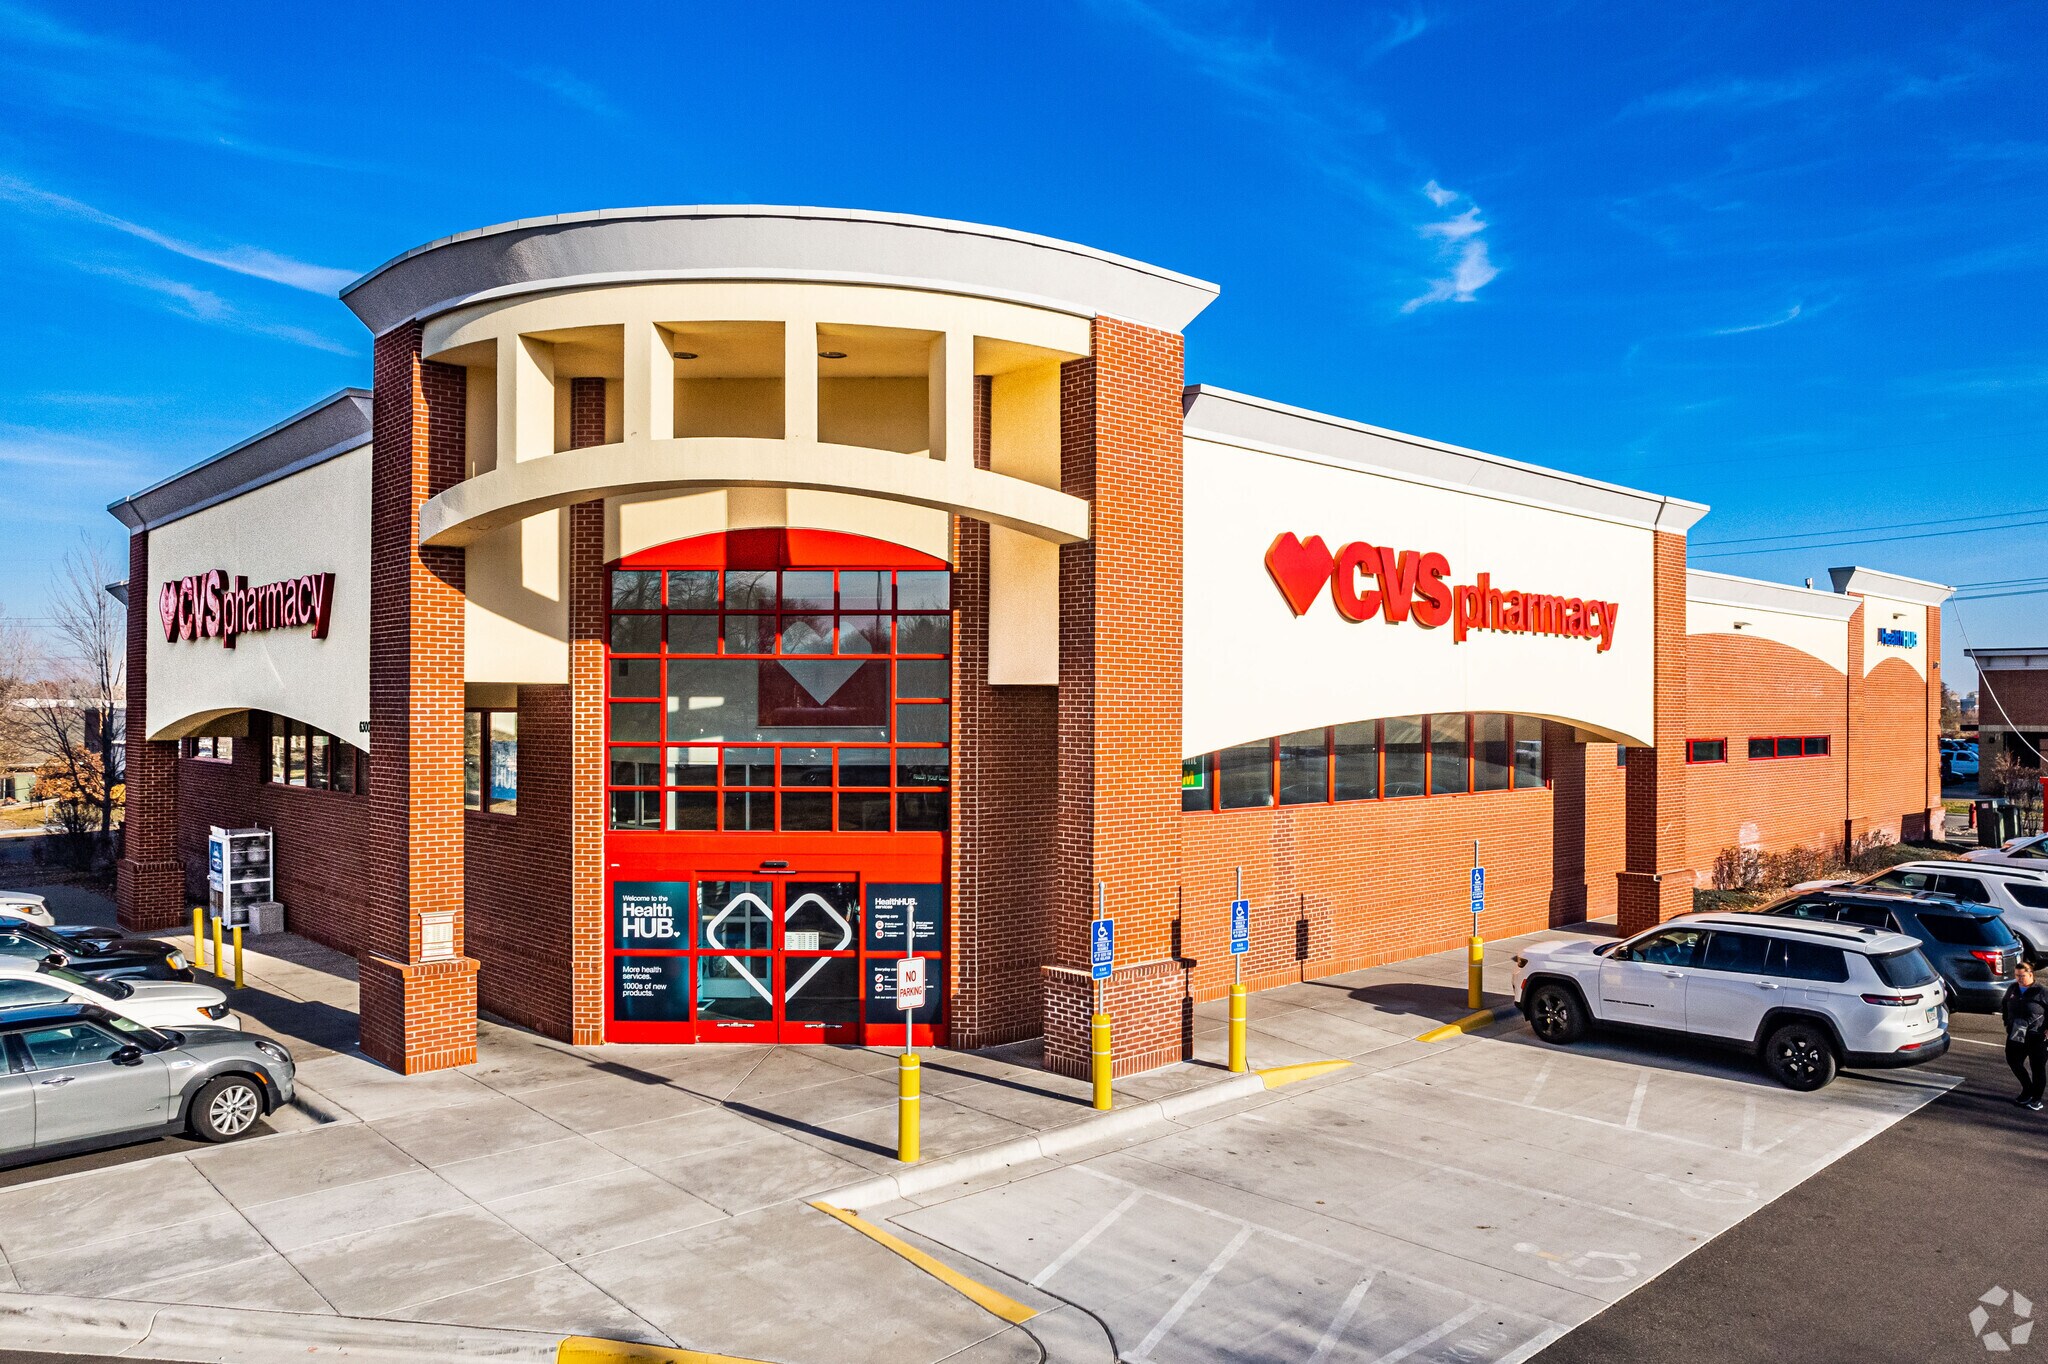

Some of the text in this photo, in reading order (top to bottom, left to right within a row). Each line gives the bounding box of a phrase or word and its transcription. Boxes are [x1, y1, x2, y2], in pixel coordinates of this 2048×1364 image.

[1330, 541, 1619, 653] CVS pharmacy
[178, 568, 336, 649] CVS pharmacy
[1878, 628, 1917, 648] HealthHUB
[622, 903, 672, 916] Health
[905, 971, 916, 982] NO
[622, 982, 644, 990] 1000s
[644, 982, 652, 990] of
[899, 985, 922, 998] PARKING
